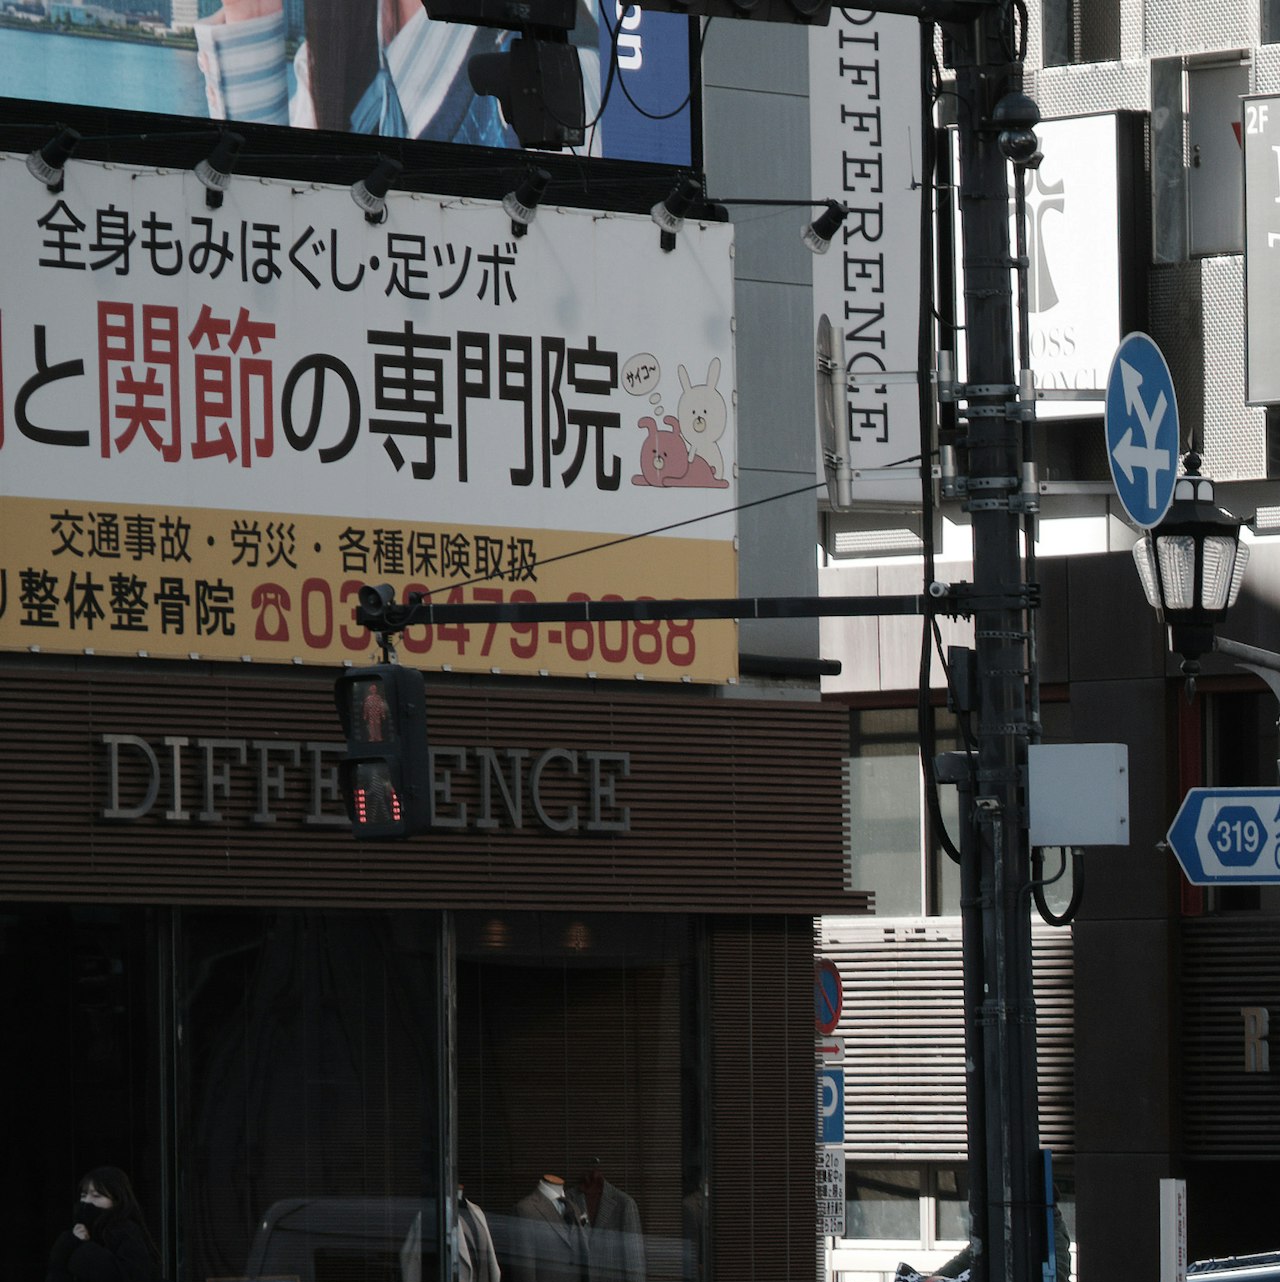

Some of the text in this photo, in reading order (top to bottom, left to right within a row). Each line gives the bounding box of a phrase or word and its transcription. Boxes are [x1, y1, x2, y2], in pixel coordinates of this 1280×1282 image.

[1246, 105, 1269, 134] 2F
[37, 200, 519, 307] 全身もみほぐし・足ツボ
[1030, 326, 1076, 358] OSS
[0, 299, 622, 492] と関節の専門院
[50, 512, 538, 584] 交通事故・労災・各種保険取扱
[102, 733, 632, 833] DIFFEENCE
[1216, 820, 1260, 854] 319
